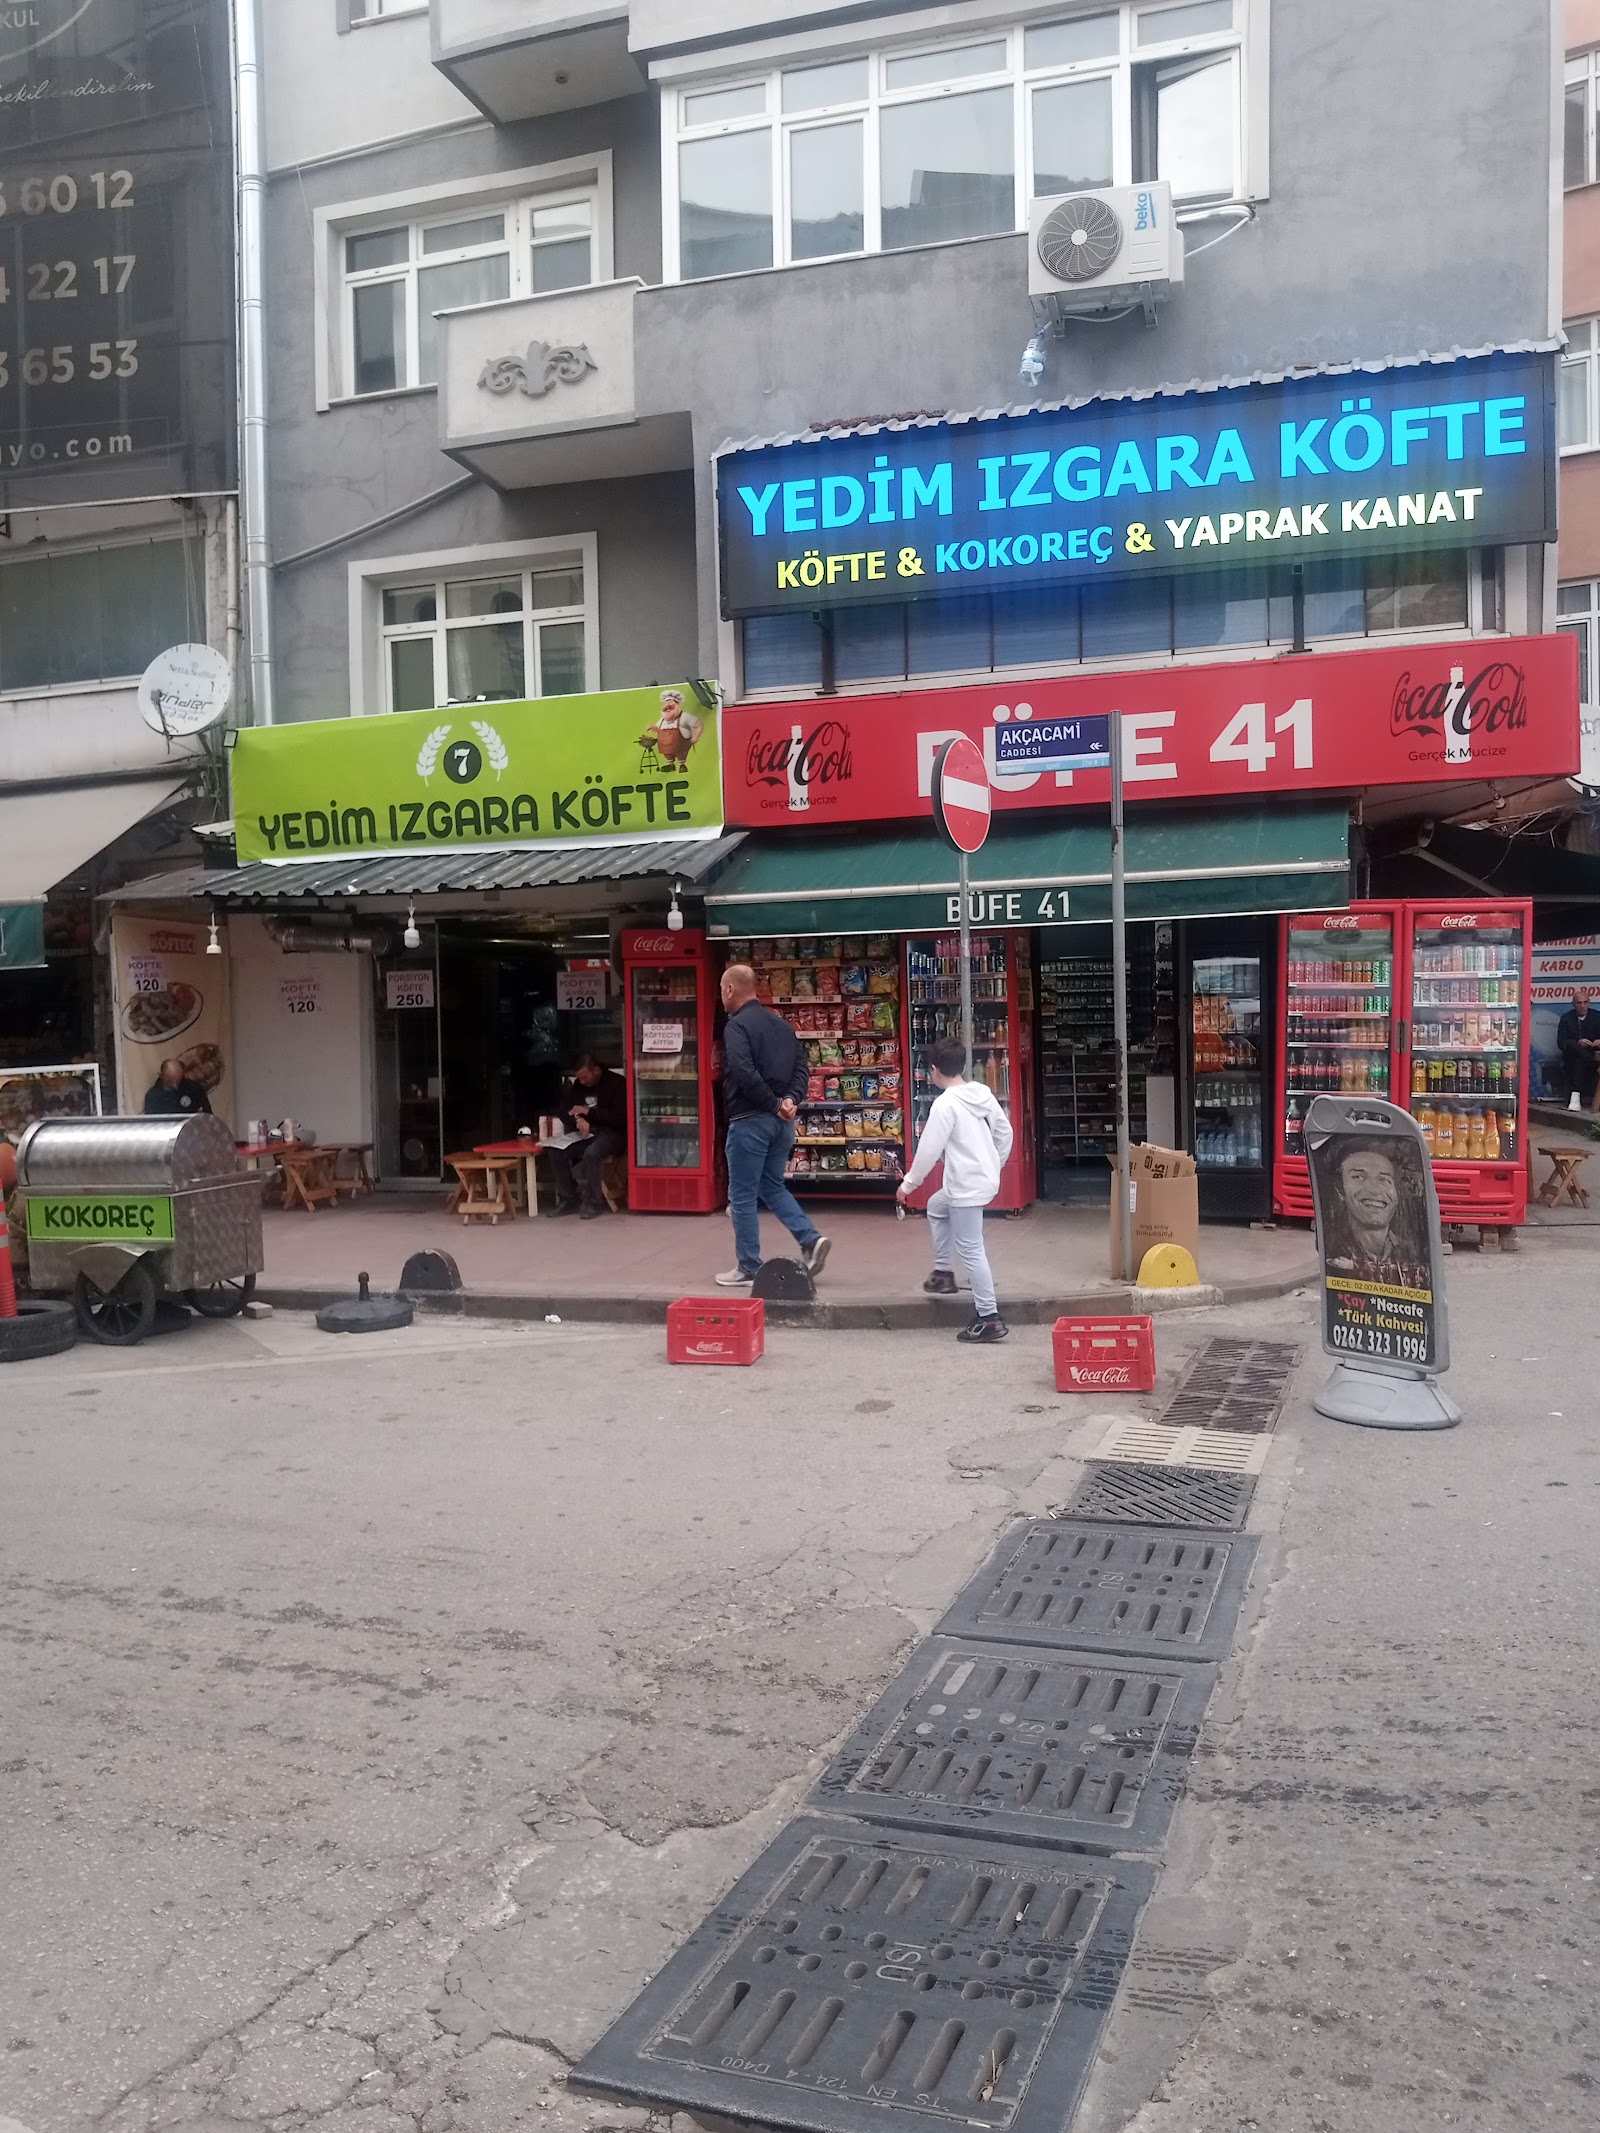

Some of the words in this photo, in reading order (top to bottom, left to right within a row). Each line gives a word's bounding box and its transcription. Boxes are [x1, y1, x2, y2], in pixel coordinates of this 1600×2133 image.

[90, 169, 135, 210] 12
[1134, 192, 1148, 231] beko
[27, 260, 78, 301] 22
[93, 255, 137, 296] 17
[22, 346, 75, 386] 65
[88, 339, 139, 381] 53
[736, 455, 953, 537] YEDİM
[977, 428, 1256, 512] IZGARA
[1280, 396, 1526, 478] KÖFTE
[776, 549, 887, 590] KÖFTE
[896, 546, 926, 578] &
[935, 525, 1114, 574] KOKOREÇ
[1124, 522, 1157, 555] &
[1164, 503, 1330, 549] YAPRAK
[1341, 487, 1483, 532] KANAT
[1001, 721, 1081, 745] AKÇACAMİ
[1209, 698, 1313, 773] 41
[453, 747, 471, 778] 7
[1000, 745, 1041, 758] CADDESİ
[1408, 748, 1456, 762] Gerçek
[1459, 745, 1507, 759] Mucize
[258, 799, 377, 853] YEDİM
[389, 794, 540, 842] IZGARA
[552, 775, 692, 832] KÖFTE
[760, 797, 797, 810] Gerçek
[800, 795, 838, 806] Mucize
[946, 890, 1022, 923] BÜFE
[1037, 890, 1070, 919] 41
[1539, 960, 1585, 973] KABLO
[135, 979, 160, 991] 120
[288, 1000, 316, 1014] 120
[395, 994, 424, 1006] 250
[566, 996, 596, 1009] 120
[44, 1205, 155, 1236] KOKOREÇ
[1379, 1287, 1403, 1295] KADAR
[1376, 1313, 1424, 1335] Kahvesi
[1333, 1324, 1363, 1350] 0262
[1367, 1330, 1391, 1355] 323
[1395, 1334, 1427, 1362] 1996
[720, 2055, 771, 2074] D400
[815, 2074, 848, 2089] 124
[865, 2084, 898, 2100] EN
